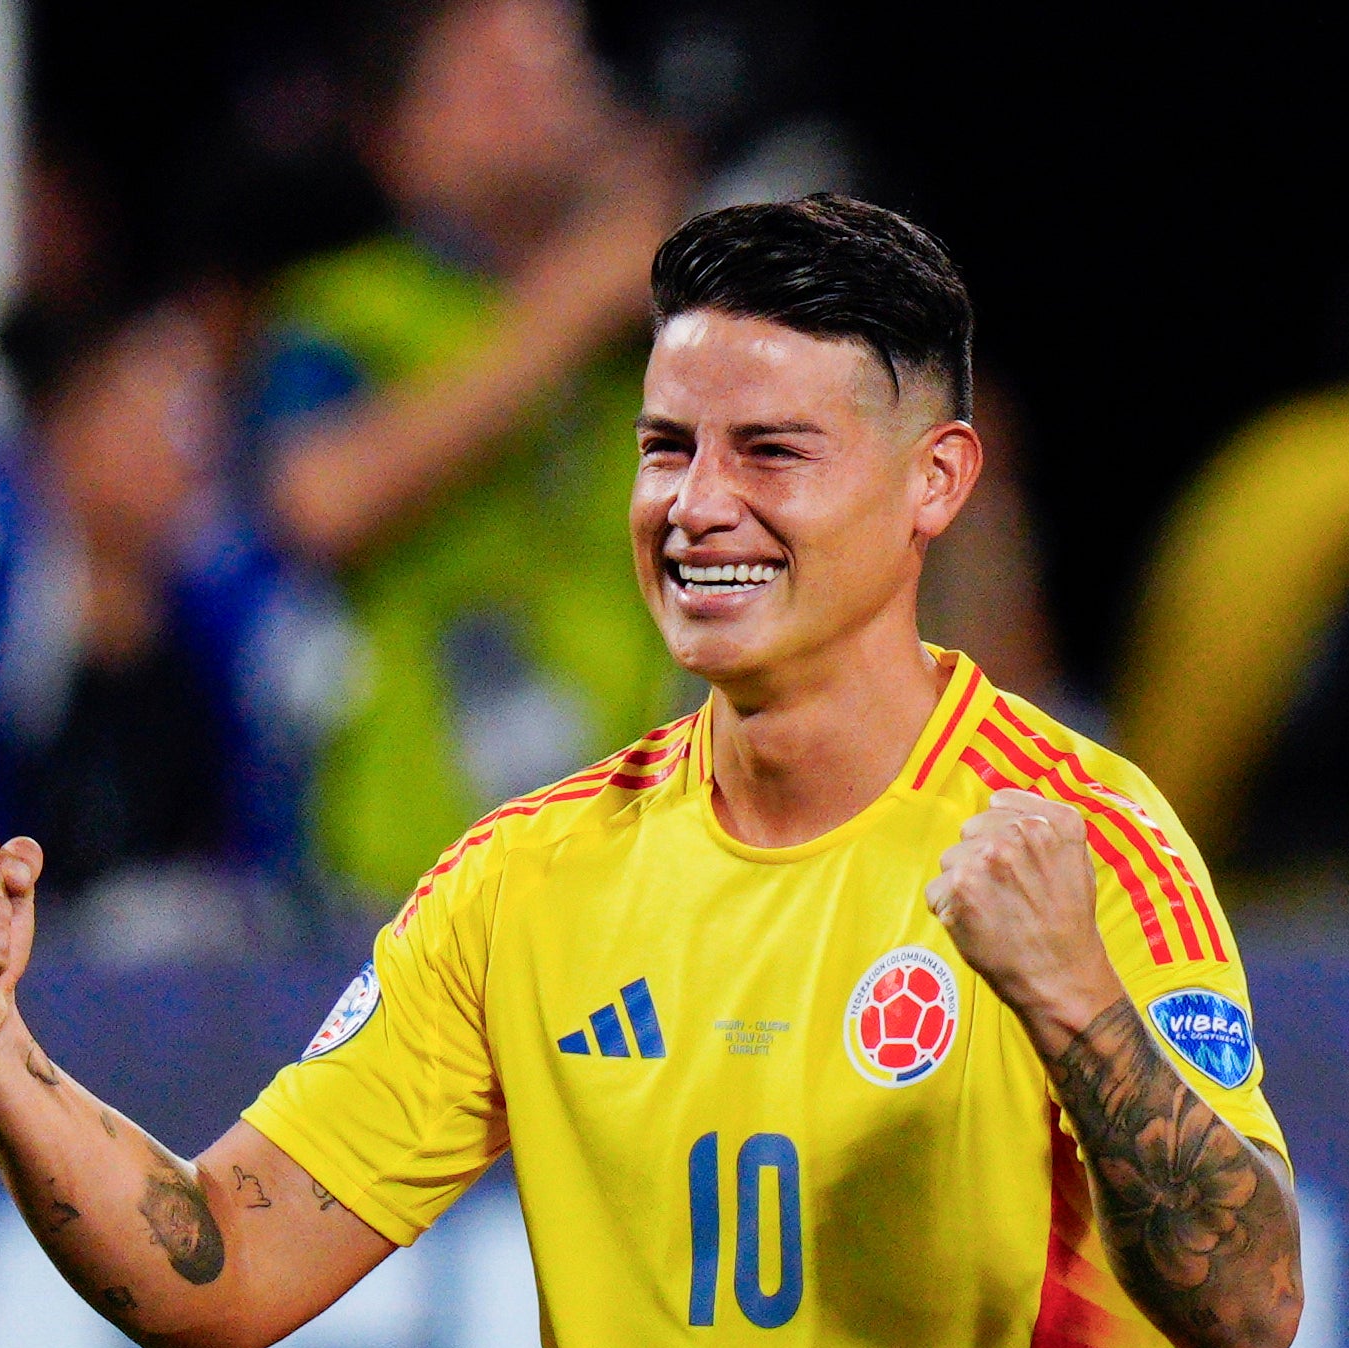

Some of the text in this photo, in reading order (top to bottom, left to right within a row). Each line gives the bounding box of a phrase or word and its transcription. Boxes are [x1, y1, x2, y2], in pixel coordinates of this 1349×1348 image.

[886, 950, 938, 970] COLOMBIANA
[936, 968, 947, 980] DE
[1169, 1014, 1244, 1039] VIBRA
[688, 1130, 803, 1328] 10
